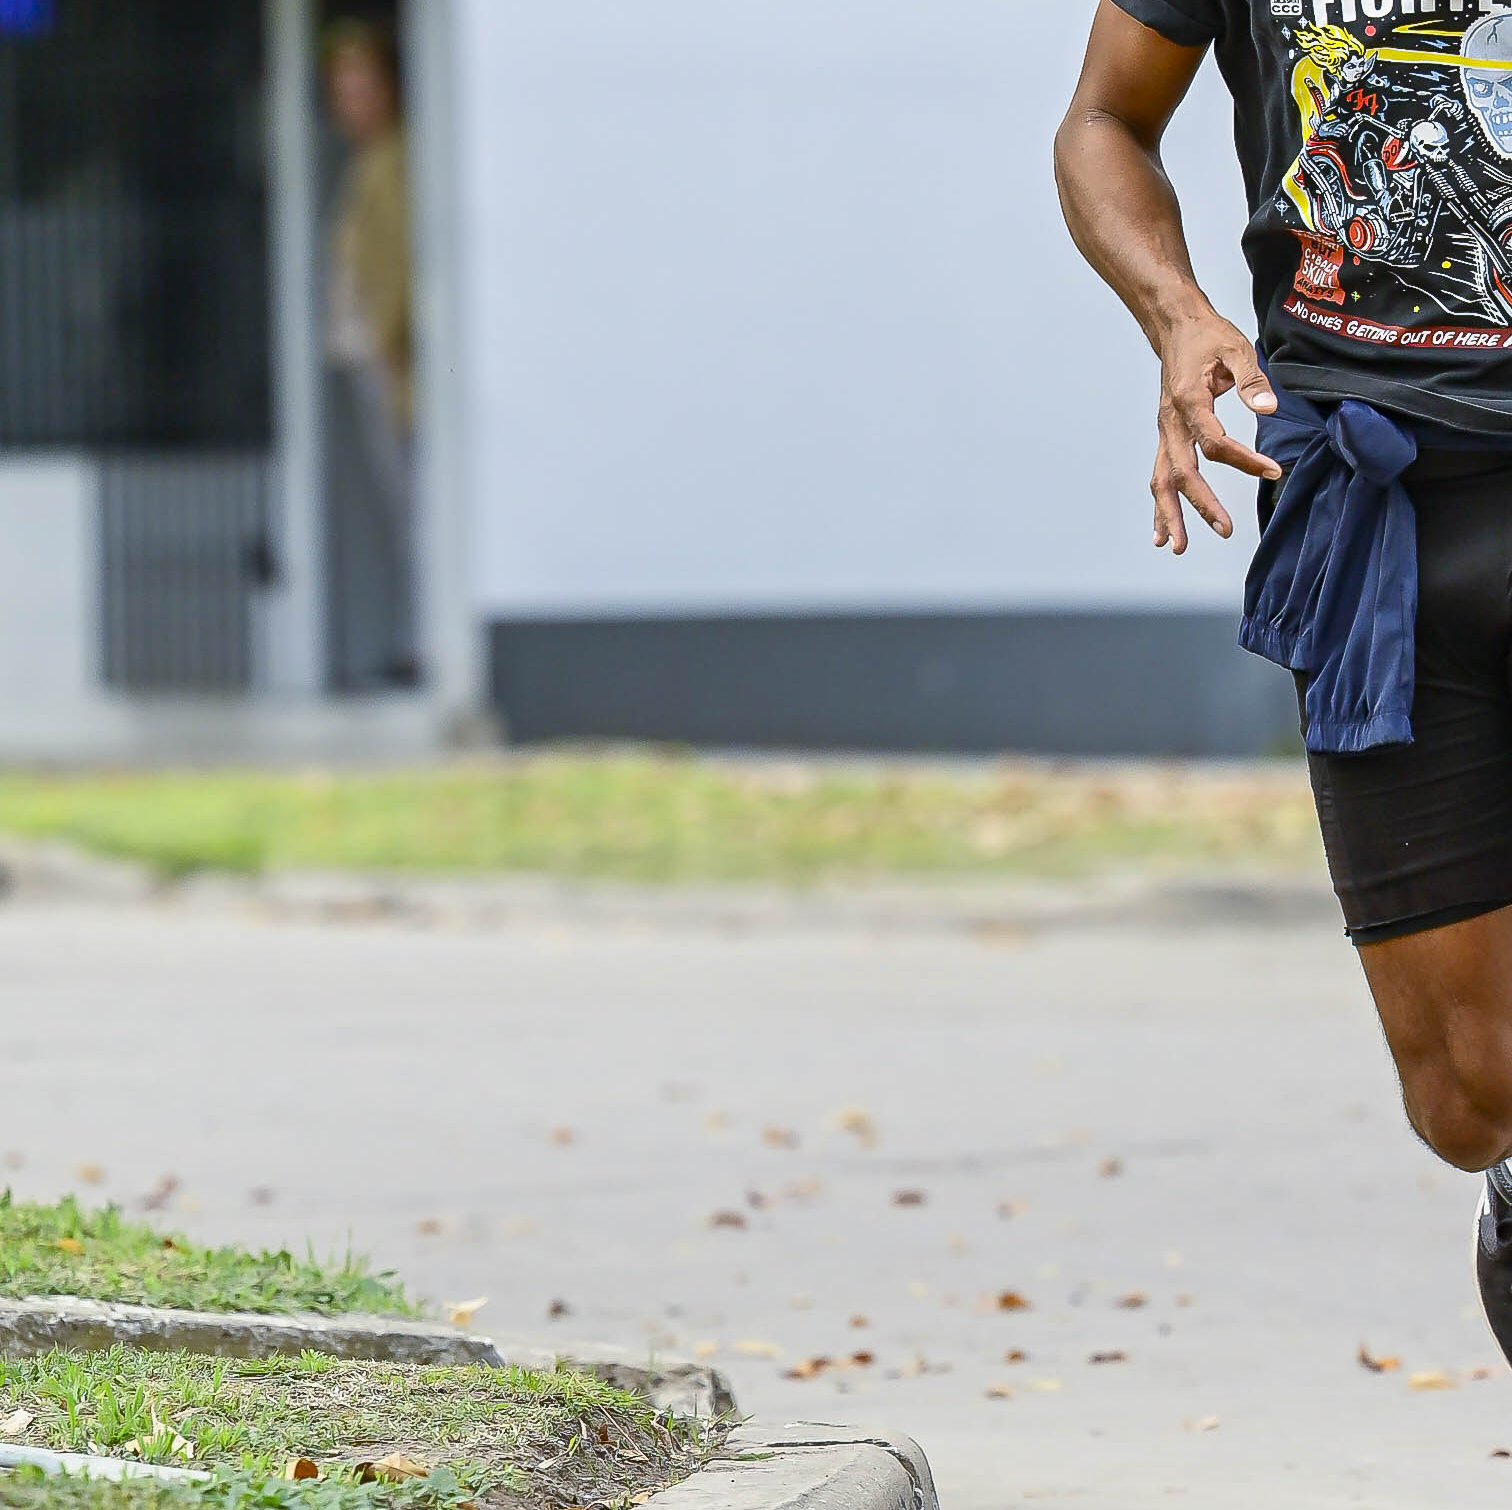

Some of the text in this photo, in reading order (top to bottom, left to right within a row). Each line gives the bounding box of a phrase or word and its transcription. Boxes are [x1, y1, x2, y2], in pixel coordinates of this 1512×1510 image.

[1272, 5, 1300, 13] CCC
[1302, 259, 1338, 289] SKULL
[1309, 312, 1343, 331] ONE'S
[1346, 321, 1398, 343] GETTING
[1401, 330, 1432, 345] OUT
[1432, 330, 1455, 345] OF
[1453, 332, 1501, 347] HERE
